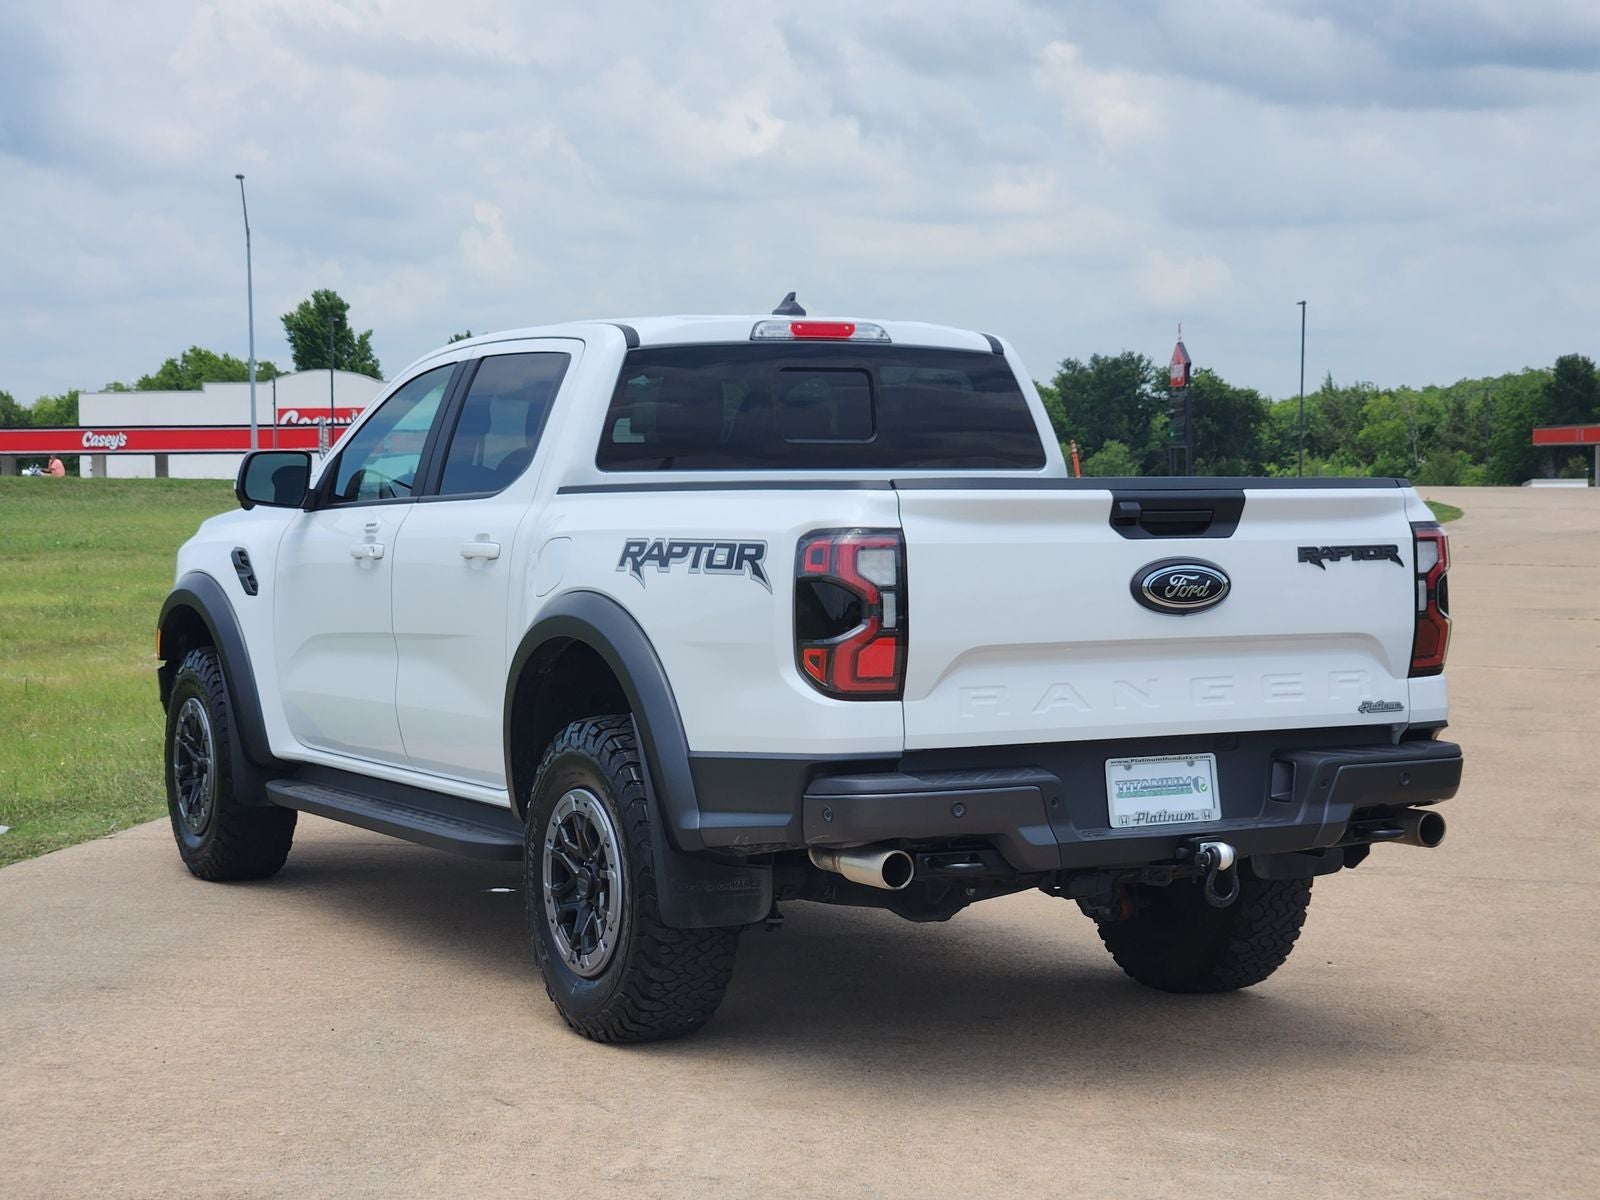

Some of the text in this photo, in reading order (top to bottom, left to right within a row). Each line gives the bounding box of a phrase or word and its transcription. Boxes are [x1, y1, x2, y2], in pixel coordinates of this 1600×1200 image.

[81, 431, 127, 450] Casey's
[615, 537, 773, 595] RAPTOR
[1297, 544, 1405, 571] RAPTOR
[1164, 574, 1211, 598] Ford
[957, 669, 1377, 719] RANGER
[1357, 699, 1405, 714] Platinum
[1115, 776, 1192, 792] TITANIUM
[1132, 808, 1200, 825] Platinum
